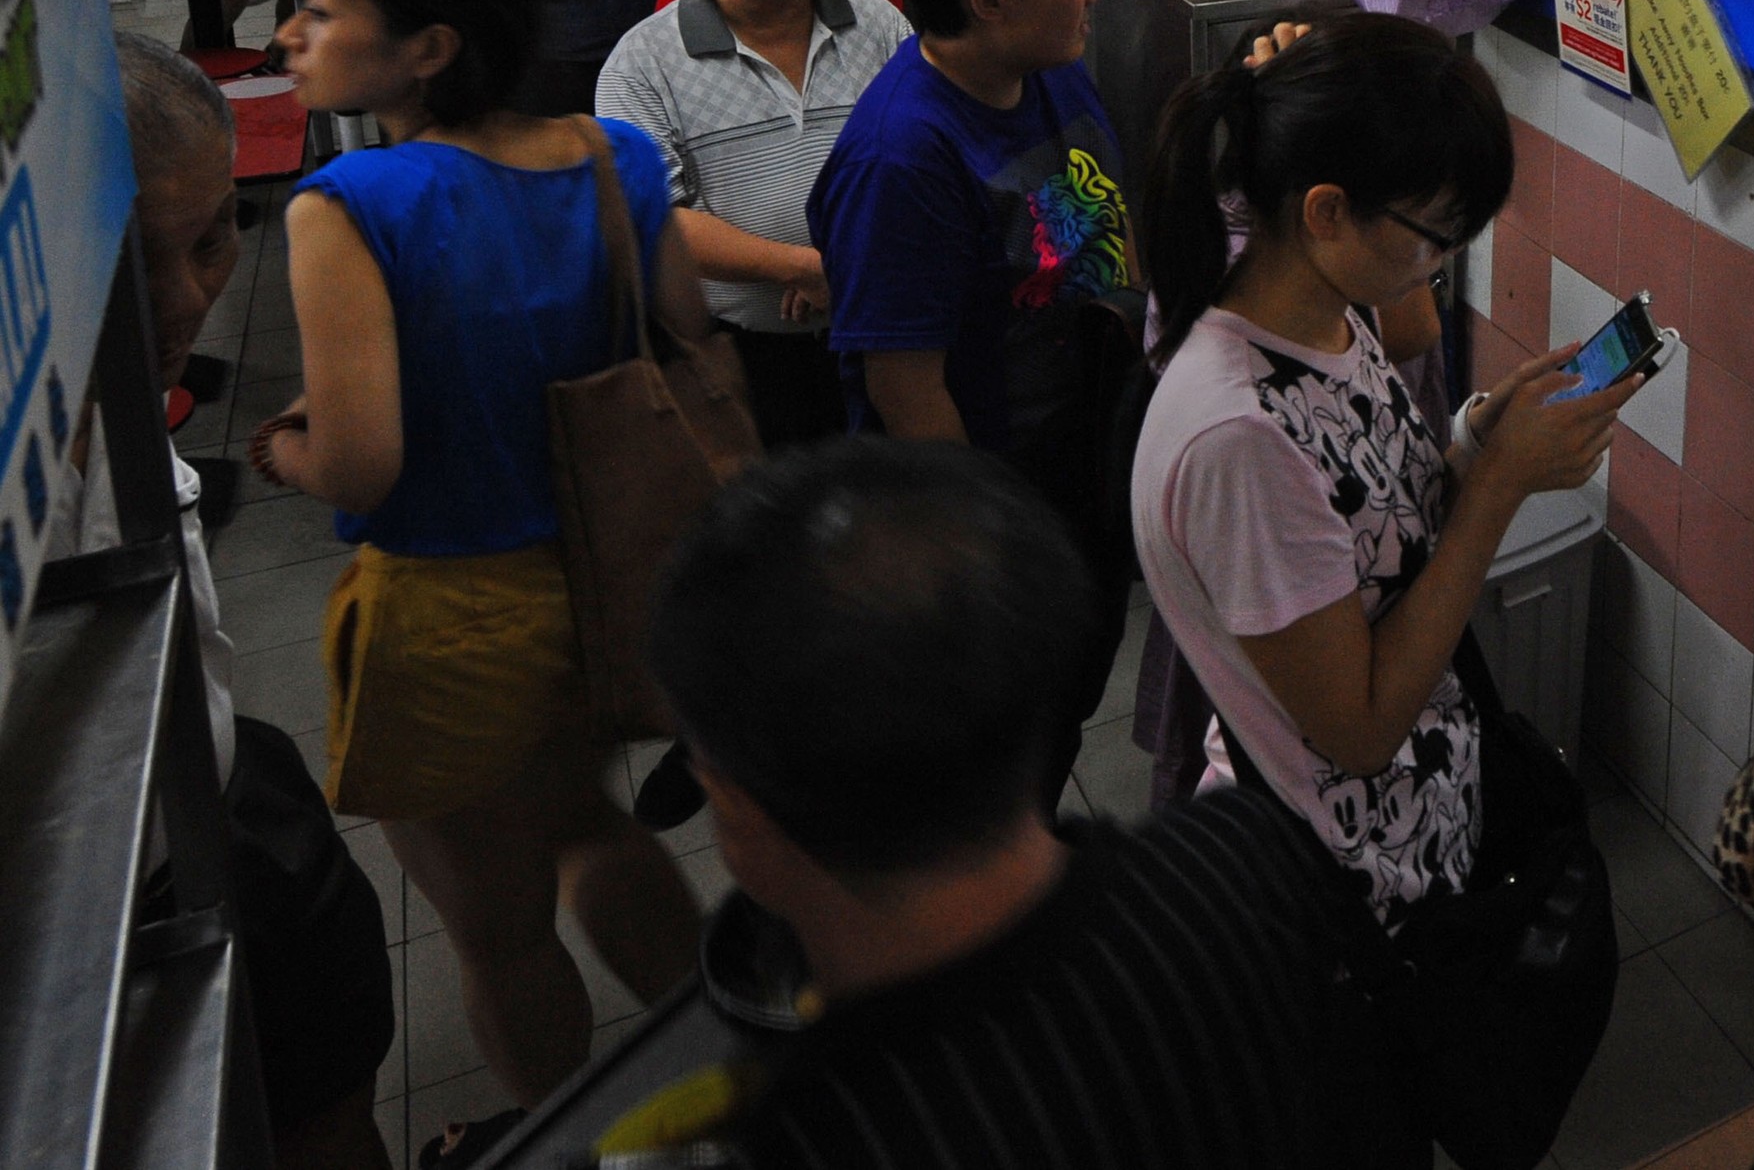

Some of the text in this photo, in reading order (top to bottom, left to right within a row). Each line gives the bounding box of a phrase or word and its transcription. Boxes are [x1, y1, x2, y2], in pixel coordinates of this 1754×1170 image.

[1658, 17, 1675, 46] Away
[1637, 31, 1682, 119] THANK YOU
